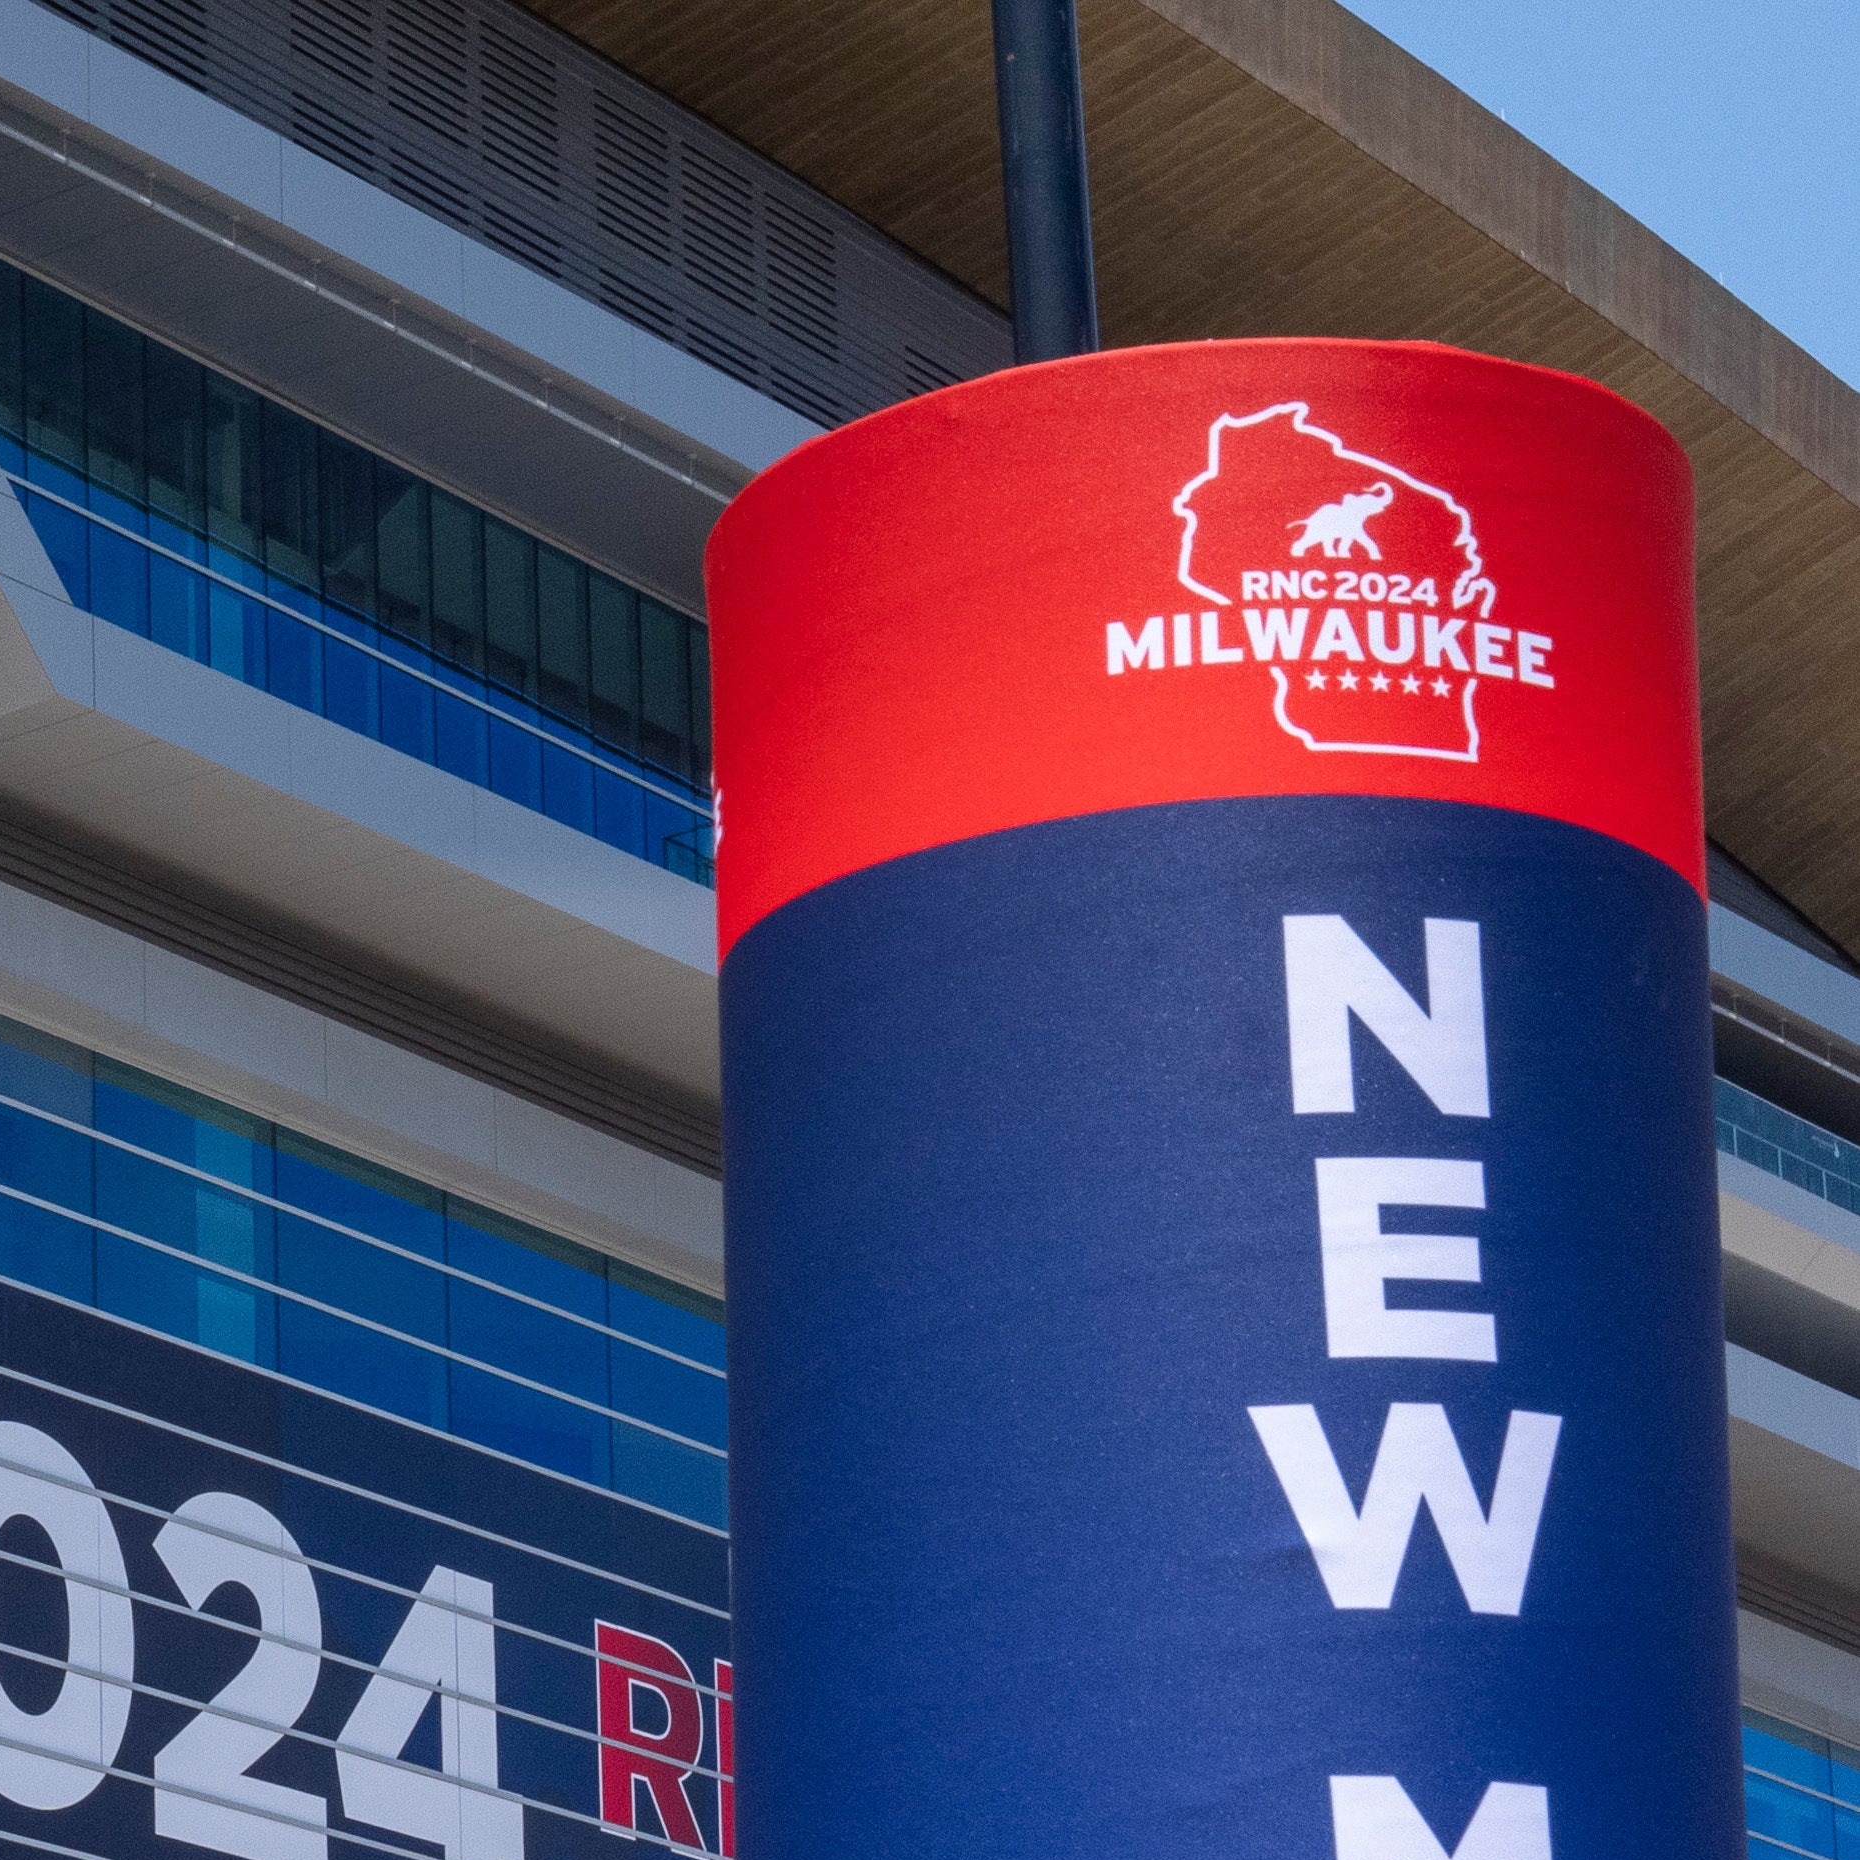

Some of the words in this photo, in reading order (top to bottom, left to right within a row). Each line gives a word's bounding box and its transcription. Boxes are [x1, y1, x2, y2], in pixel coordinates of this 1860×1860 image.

[1241, 570, 1328, 601] RNC
[1334, 570, 1439, 607] 2024
[1105, 608, 1555, 689] MILWAUKEE
[1247, 914, 1562, 1616] NEW
